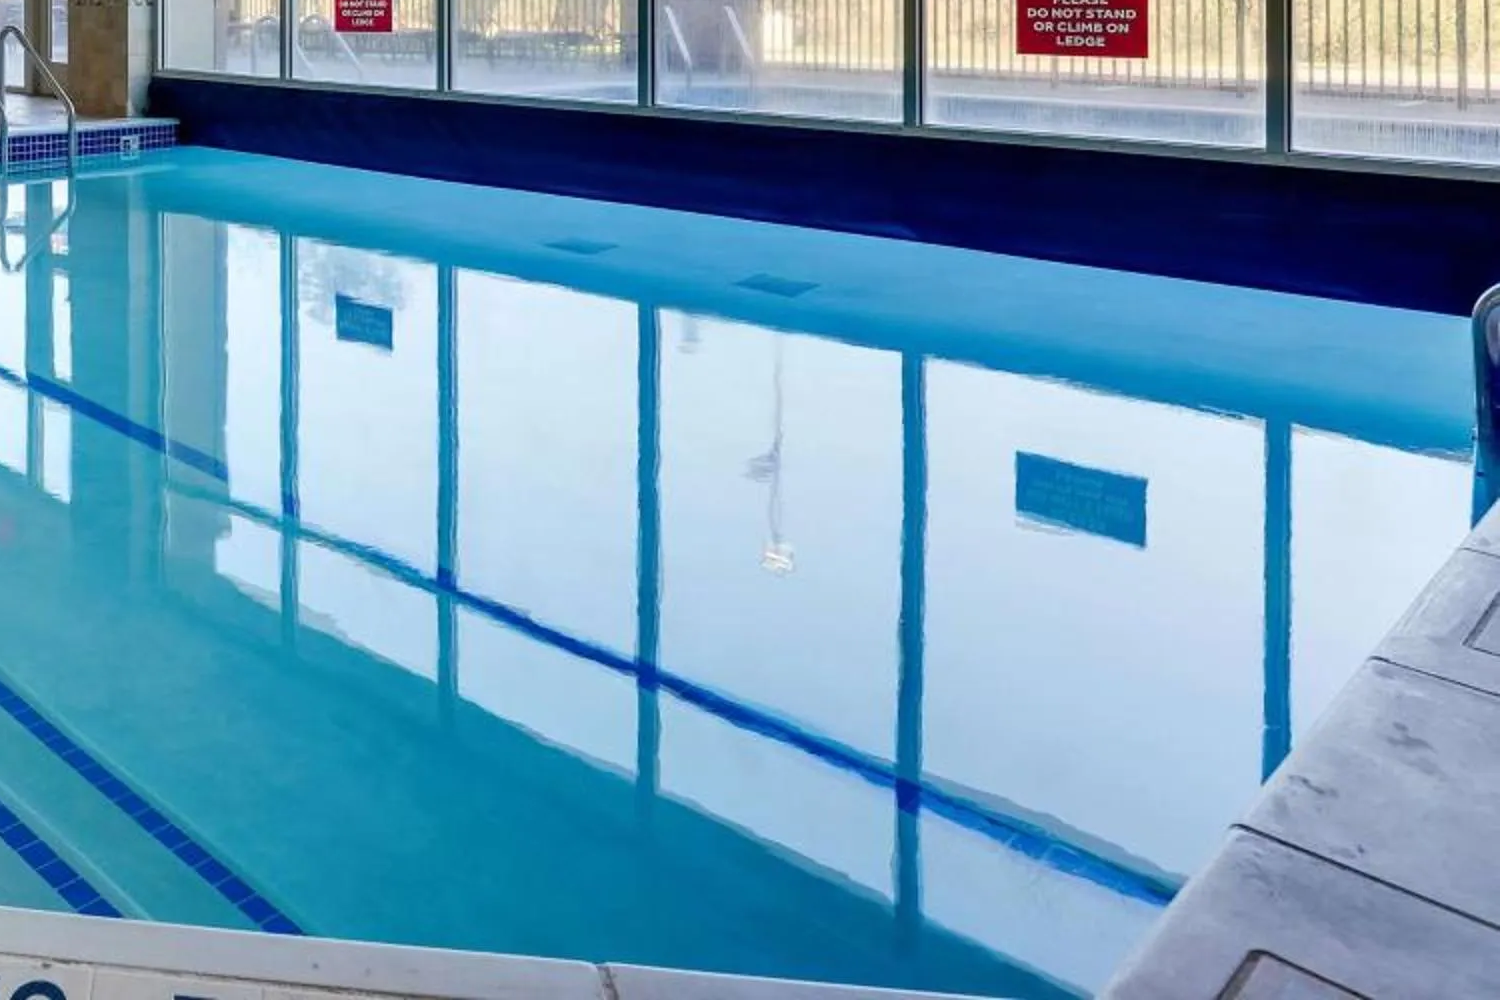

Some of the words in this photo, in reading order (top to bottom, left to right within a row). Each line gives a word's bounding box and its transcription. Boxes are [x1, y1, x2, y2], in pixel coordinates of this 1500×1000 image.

[1027, 7, 1049, 18] DO
[1051, 8, 1084, 19] NOT
[1086, 9, 1137, 19] STAND
[1033, 21, 1054, 32] OR
[1057, 21, 1103, 33] CLIMB
[1106, 23, 1129, 33] ON
[1056, 35, 1105, 47] LEDGE
